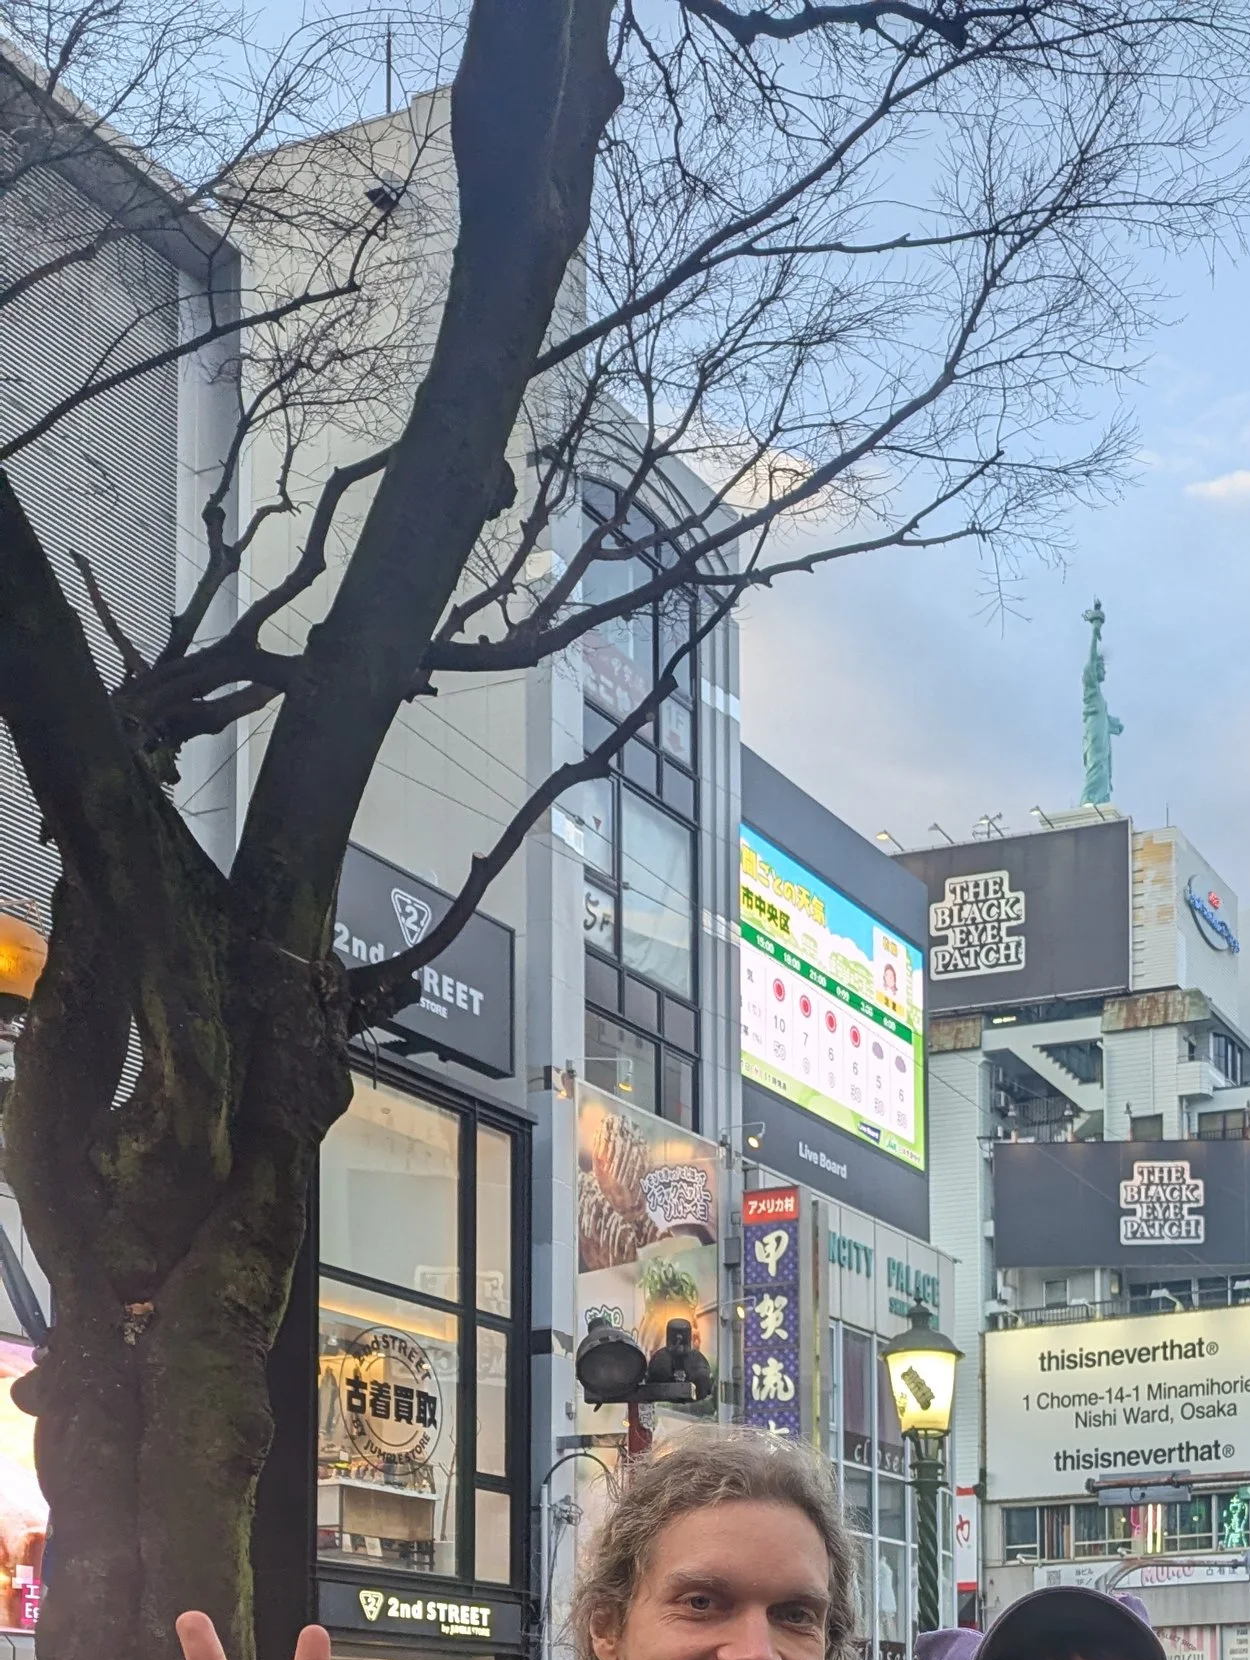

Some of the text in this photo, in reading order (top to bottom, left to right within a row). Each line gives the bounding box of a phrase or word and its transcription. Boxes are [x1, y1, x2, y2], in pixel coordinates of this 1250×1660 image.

[949, 877, 1002, 904] THE
[935, 897, 1018, 929] BLACK
[333, 922, 385, 964] 2nd
[953, 922, 1001, 947] EYE
[935, 941, 1018, 972] PATCH
[773, 1015, 786, 1033] 10
[803, 1032, 809, 1046] 7
[829, 1048, 835, 1061] 6
[853, 1062, 859, 1076] 6
[799, 1140, 847, 1179] Live Board
[1138, 1167, 1184, 1184] THE
[748, 1196, 794, 1216] アメリカ村
[1125, 1184, 1197, 1202] BLACK
[1141, 1202, 1182, 1219] EYE
[1125, 1219, 1197, 1238] PATCH
[887, 1256, 939, 1308] PALACE
[381, 1334, 432, 1382] STREET
[346, 1376, 437, 1429] 古着買取
[1022, 1395, 1030, 1411] 1
[1037, 1386, 1139, 1410] Chome-14-1
[1075, 1400, 1237, 1429] Nishi Ward, Osaka
[387, 1597, 423, 1620] 2nd
[426, 1601, 491, 1628] STREET
